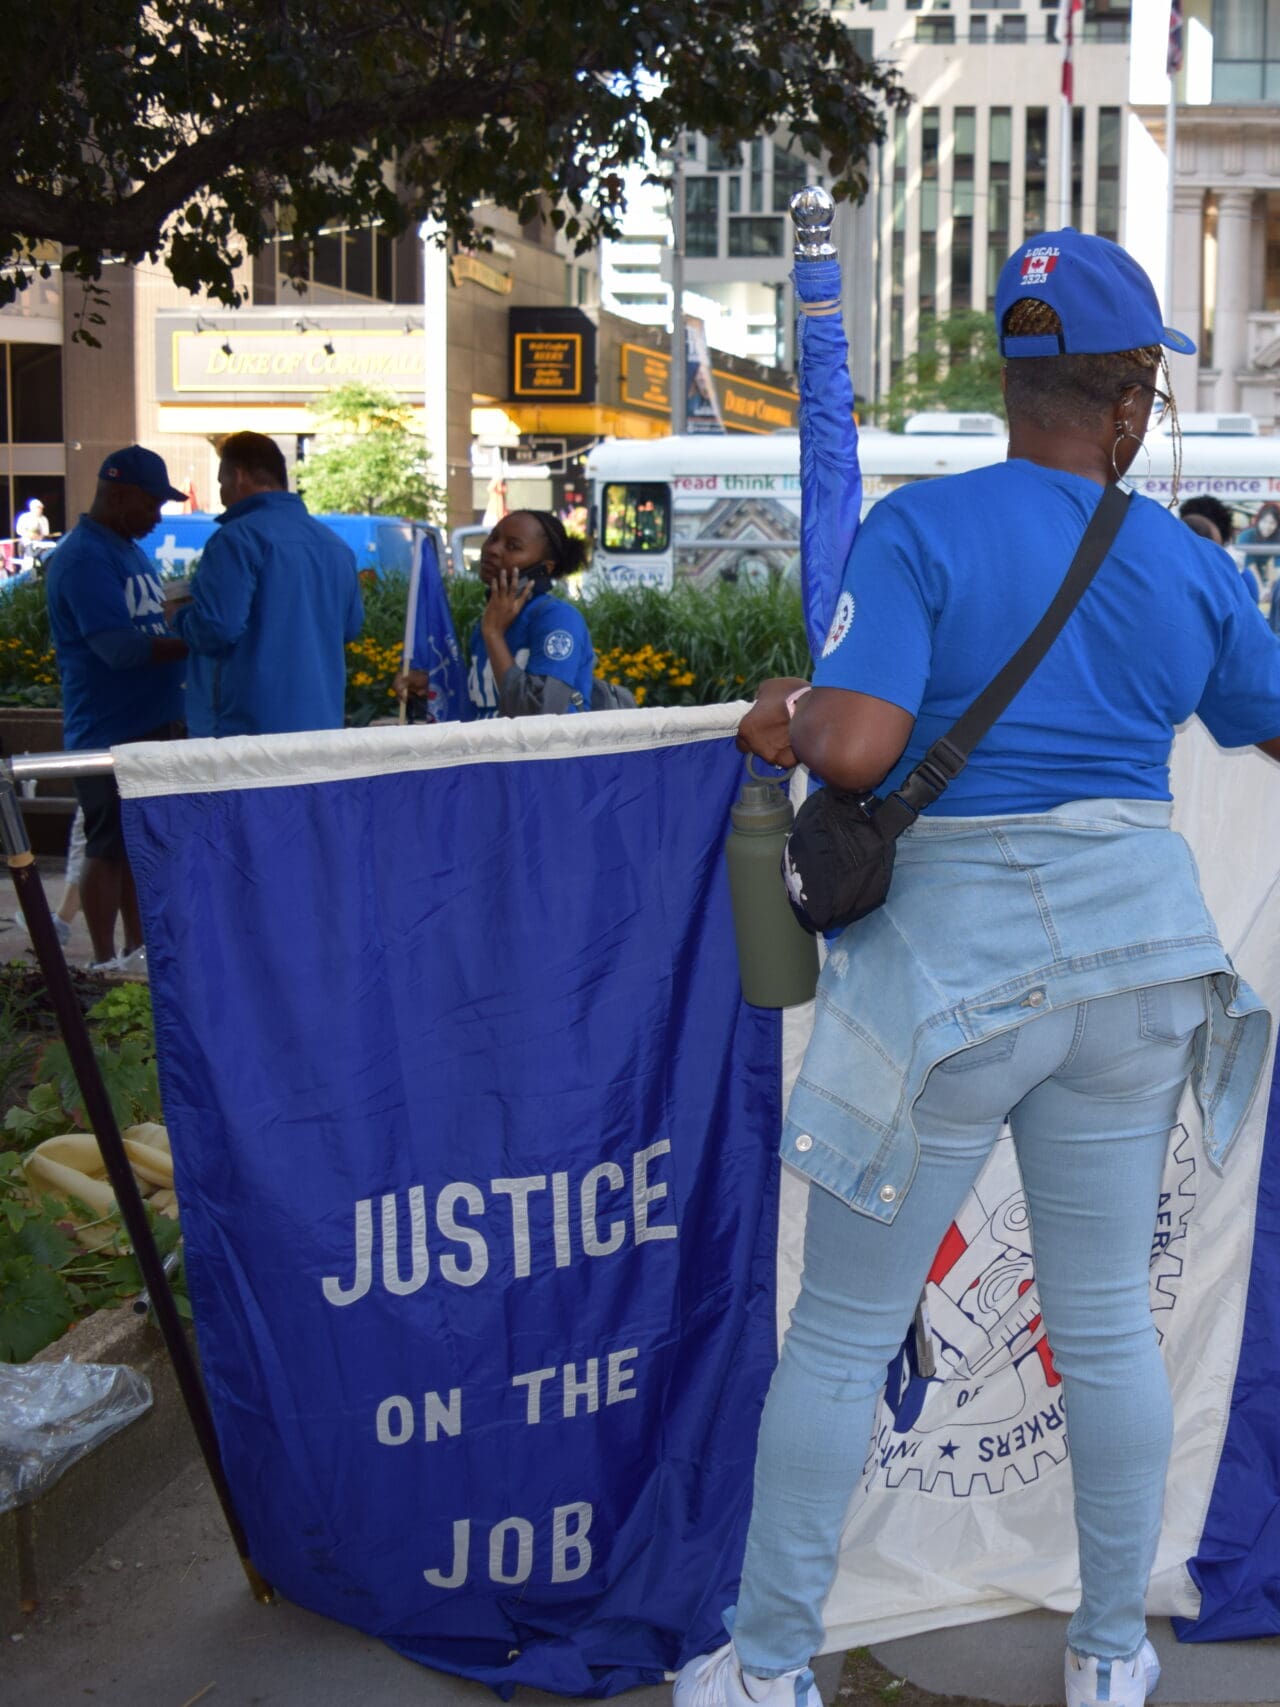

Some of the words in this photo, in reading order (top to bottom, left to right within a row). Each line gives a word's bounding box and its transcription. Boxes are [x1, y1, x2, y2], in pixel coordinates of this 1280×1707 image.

[1025, 247, 1060, 257] LOCAL
[674, 474, 717, 490] read
[723, 474, 775, 490] think
[1145, 477, 1261, 496] experience
[322, 1138, 678, 1307] JUSTICE
[376, 1388, 462, 1446] ON
[512, 1346, 639, 1425] THE
[957, 1384, 984, 1408] OF
[423, 1501, 594, 1589] JOB
